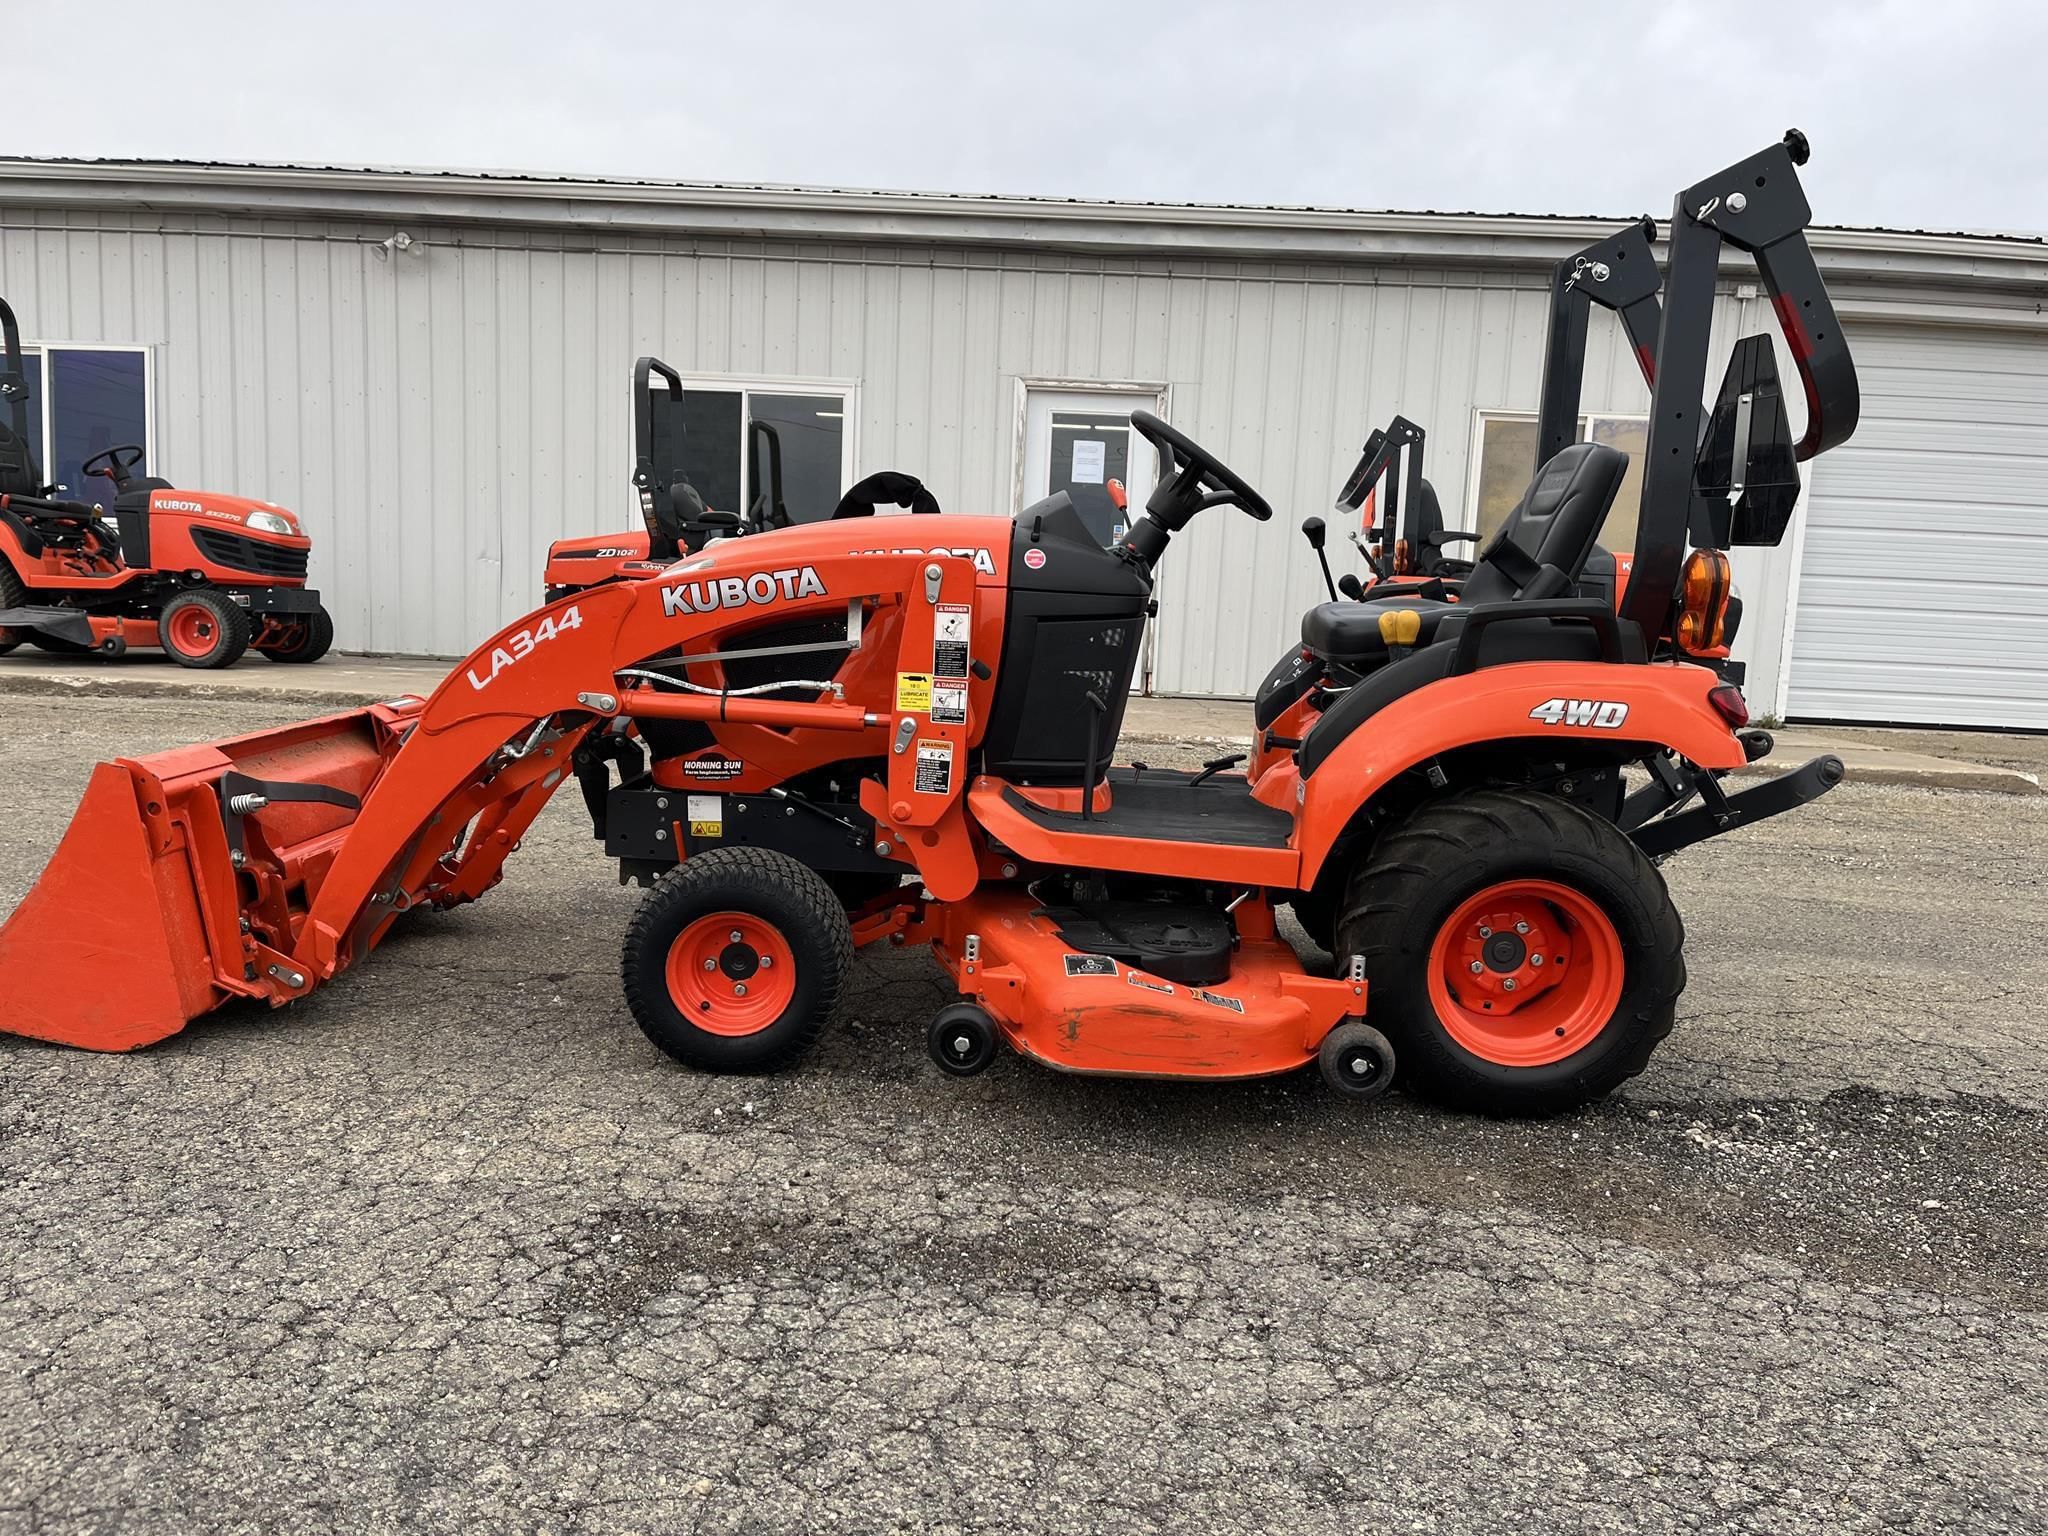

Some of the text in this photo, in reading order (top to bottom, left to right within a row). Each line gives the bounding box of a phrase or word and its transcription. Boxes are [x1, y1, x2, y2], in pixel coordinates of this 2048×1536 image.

[154, 499, 202, 513] KUBOTA
[661, 565, 828, 617] KUBOTA
[466, 605, 583, 691] LA344
[1528, 697, 1630, 729] 4WD
[684, 761, 742, 769] MORNING SUN
